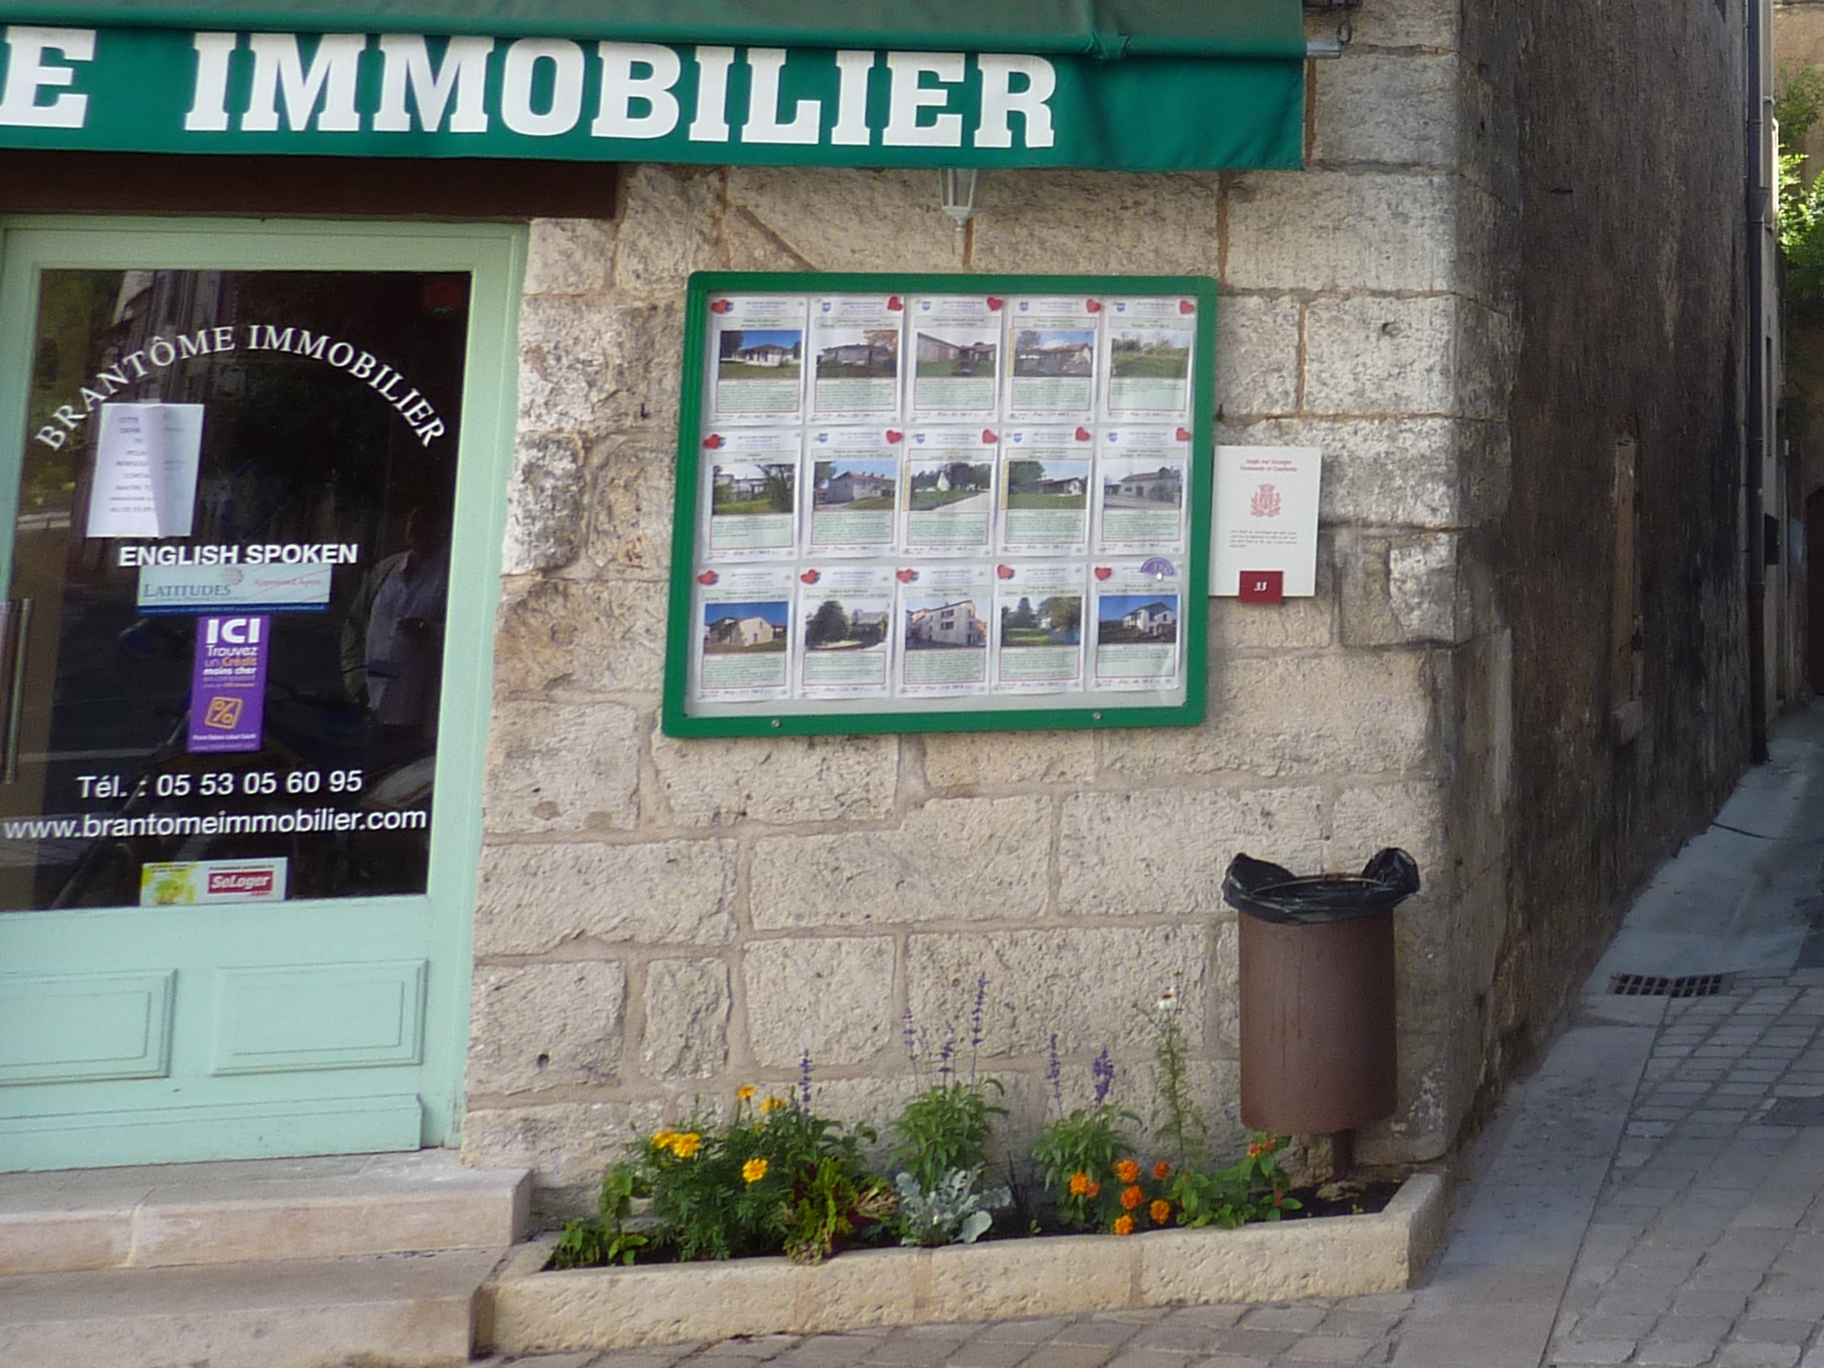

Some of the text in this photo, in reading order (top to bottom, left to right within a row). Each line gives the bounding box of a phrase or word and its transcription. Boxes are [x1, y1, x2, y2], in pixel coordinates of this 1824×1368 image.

[184, 33, 1056, 149] IMMOBILIER
[35, 325, 237, 451] BRANTÔME
[247, 324, 445, 448] IMMOBILIER
[117, 543, 358, 567] ENGLISH SPOKEN
[143, 583, 232, 598] LATITUDES
[205, 618, 261, 644] ICI
[206, 644, 259, 657] Trouvez
[76, 775, 127, 798] Tél.
[156, 774, 191, 797] 05
[199, 773, 234, 797] 53
[243, 772, 278, 796] 05
[286, 771, 320, 795] 60
[328, 770, 363, 793] 95
[3, 808, 428, 839] www.brantomeimmobilier.com
[211, 874, 271, 891] SeLoger
